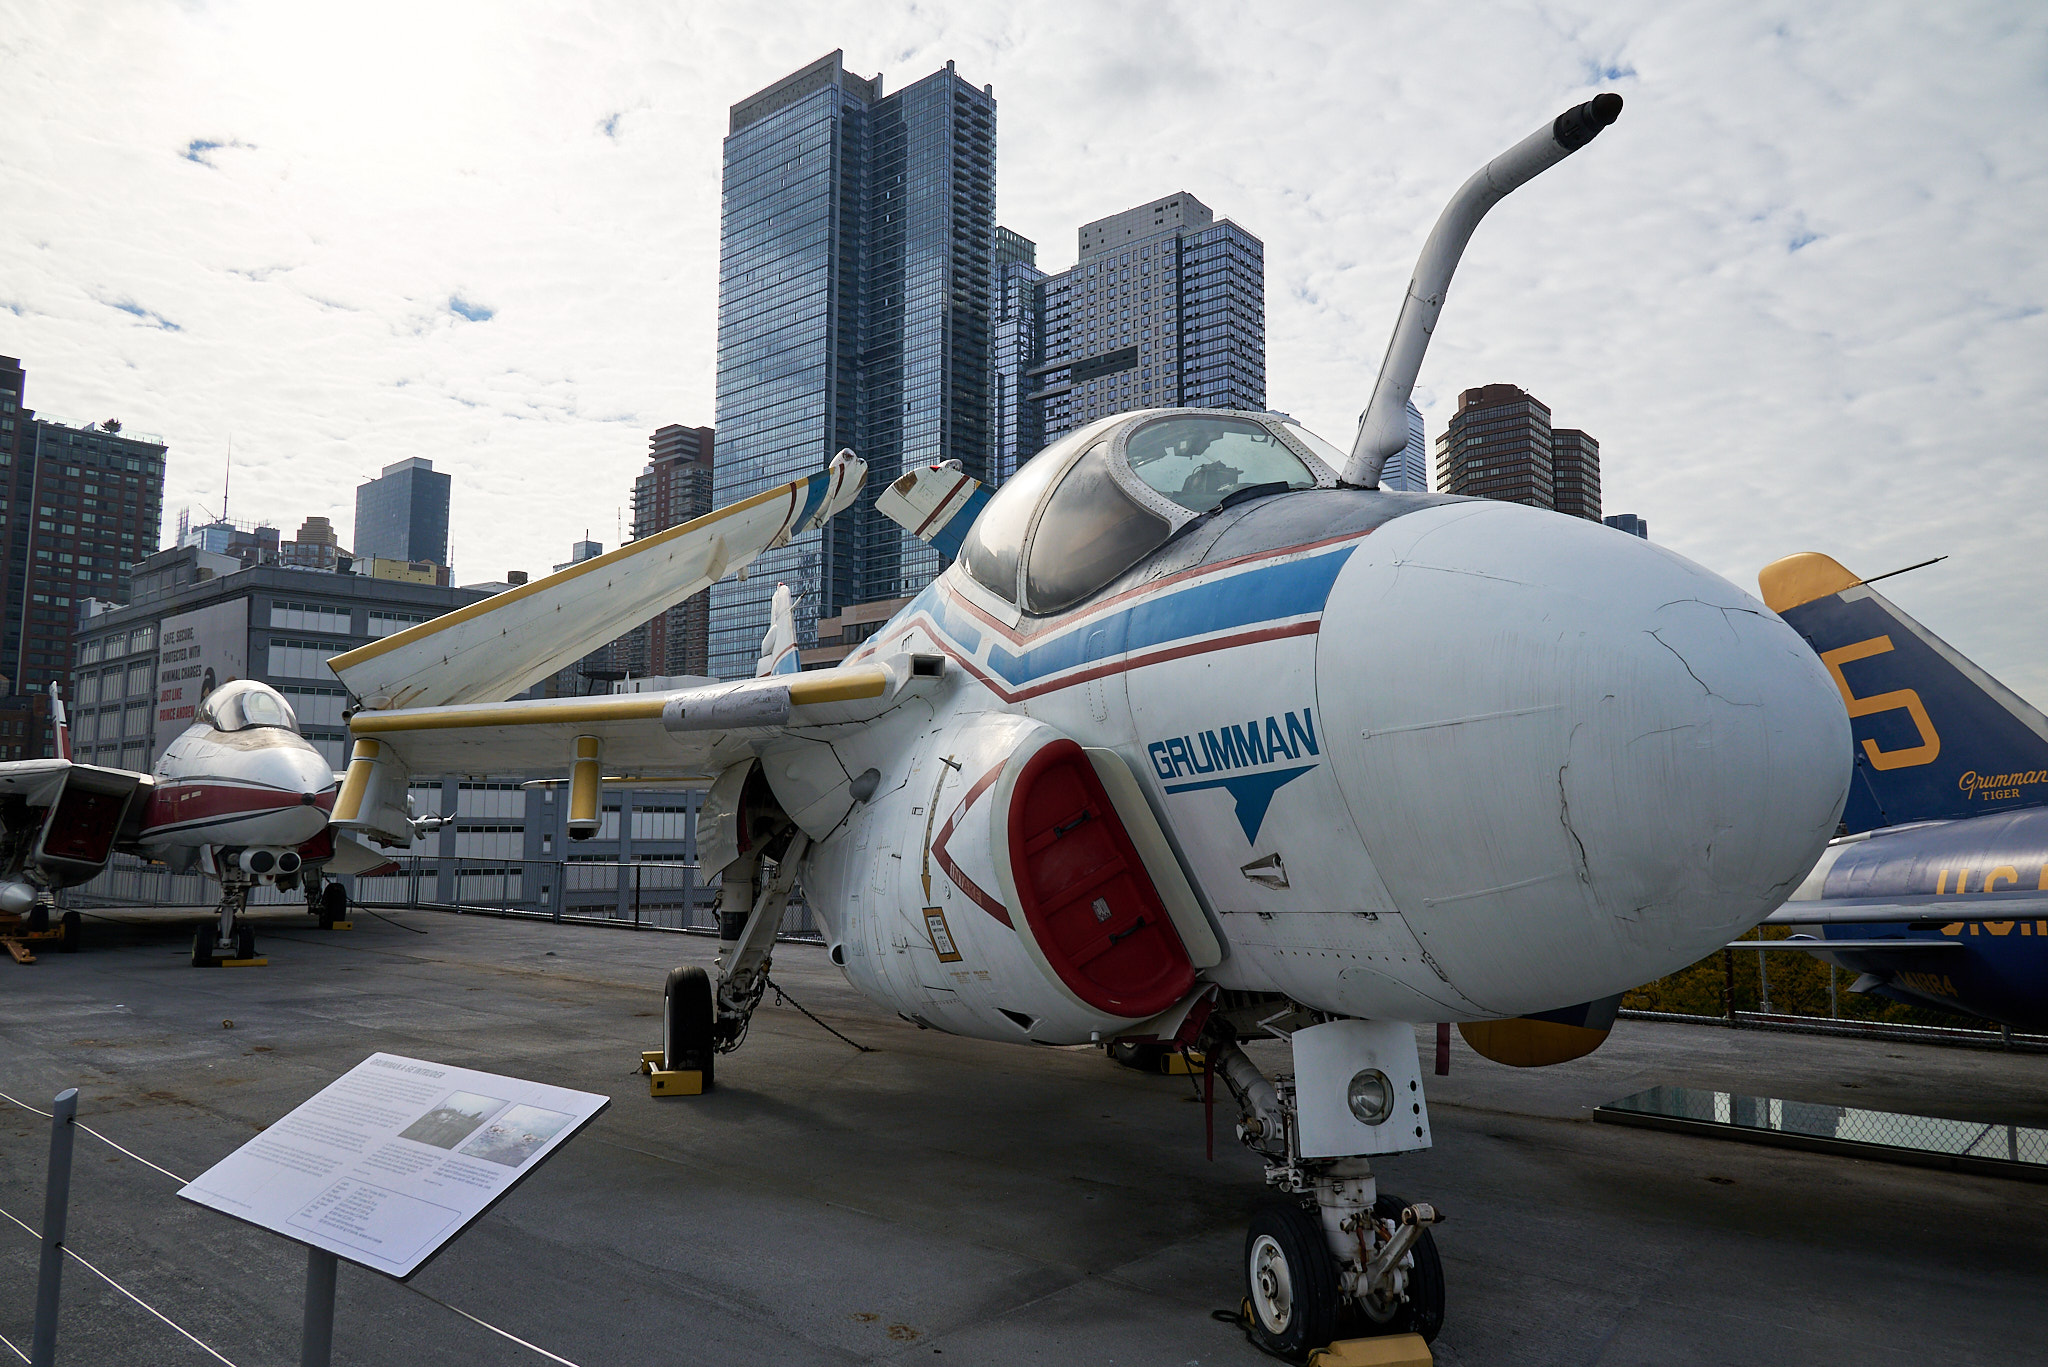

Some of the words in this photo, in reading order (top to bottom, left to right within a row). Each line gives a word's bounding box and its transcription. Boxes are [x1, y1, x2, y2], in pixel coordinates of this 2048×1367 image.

[163, 631, 175, 645] SAFE,
[176, 627, 194, 642] SECURE,
[162, 649, 188, 664] PROTECTED,
[188, 645, 200, 659] WITH
[161, 668, 181, 683] MINIMAL
[181, 665, 202, 680] CHARGES
[160, 689, 172, 703] JUST
[172, 687, 183, 701] LIKE
[1819, 634, 1941, 771] 5
[159, 707, 176, 722] PRINCE
[176, 705, 195, 720] ANDREW
[1147, 707, 1320, 779] GRUMMAN
[1958, 769, 2048, 800] Grumman
[1981, 788, 2021, 801] TIGER
[949, 860, 983, 905] INTAKE
